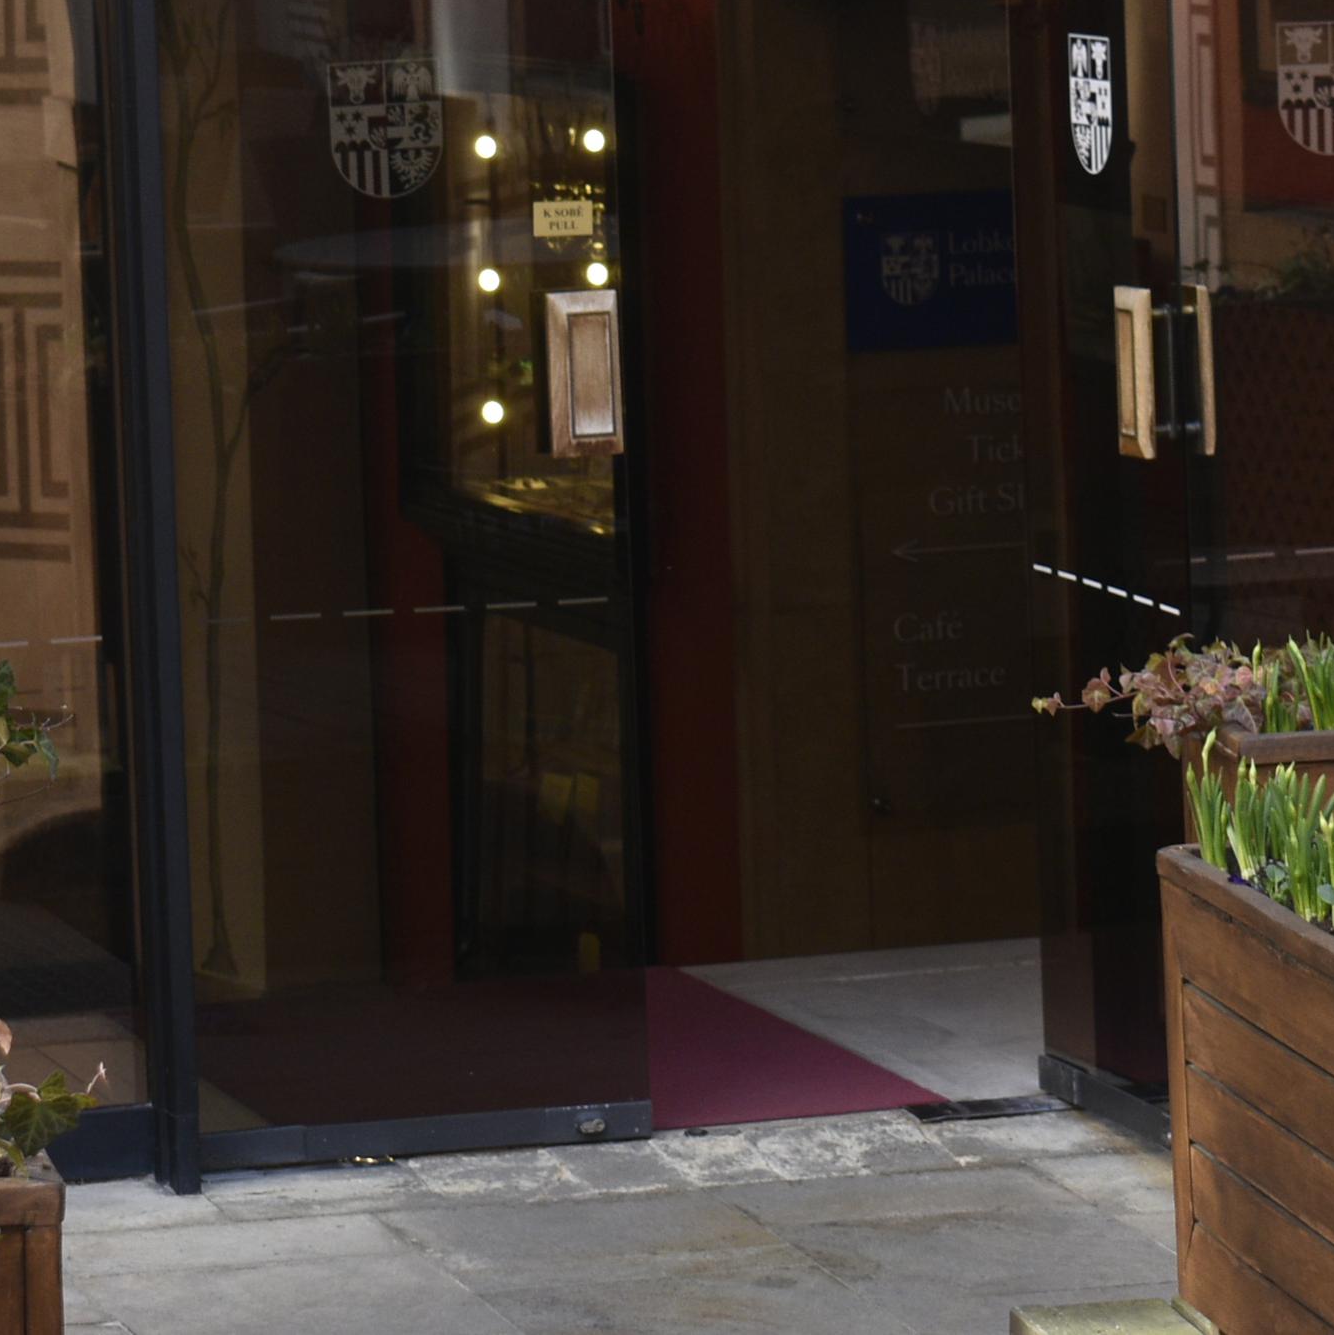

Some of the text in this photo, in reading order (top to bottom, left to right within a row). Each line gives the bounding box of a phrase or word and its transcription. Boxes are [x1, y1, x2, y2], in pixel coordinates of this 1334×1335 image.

[549, 220, 579, 230] PULL
[893, 609, 963, 643] Café
[894, 663, 1006, 691] Terrace
